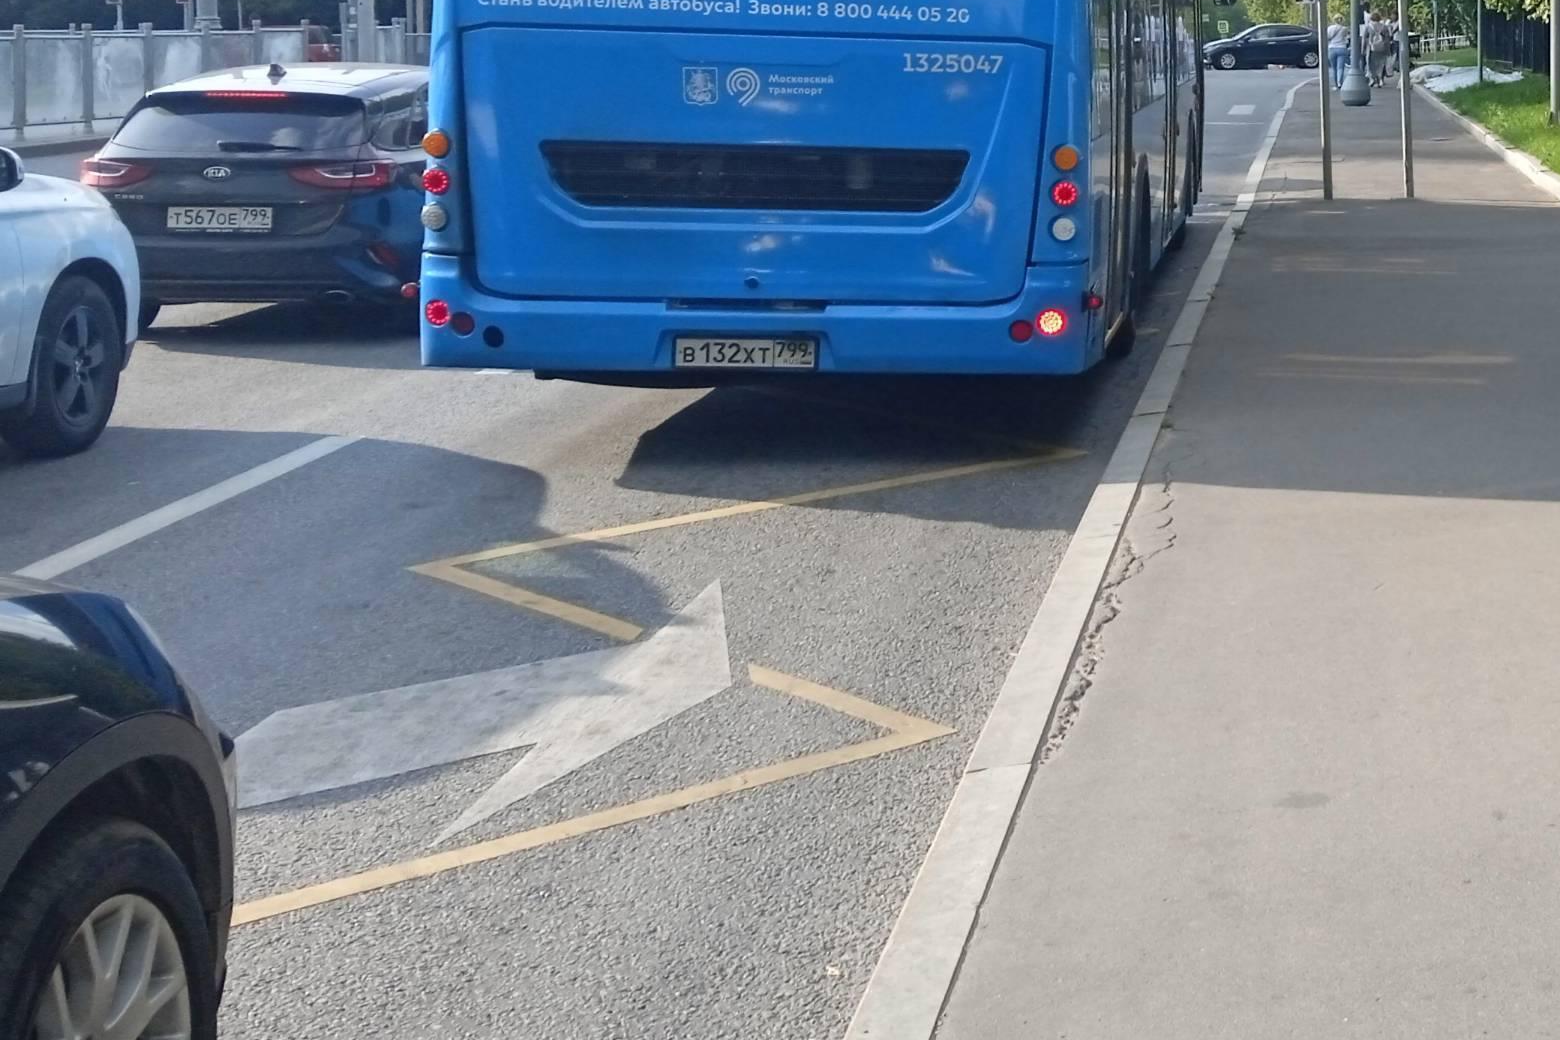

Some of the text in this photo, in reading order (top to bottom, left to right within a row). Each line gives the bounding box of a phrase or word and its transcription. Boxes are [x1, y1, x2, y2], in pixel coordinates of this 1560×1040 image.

[748, 0, 812, 17] Звони:
[816, 2, 829, 17] 8
[834, 3, 873, 19] 800
[876, 5, 913, 21] 444
[917, 6, 941, 22] 05
[902, 52, 1004, 75] 1325047
[768, 73, 835, 85] Московский
[768, 85, 824, 97] транспорт
